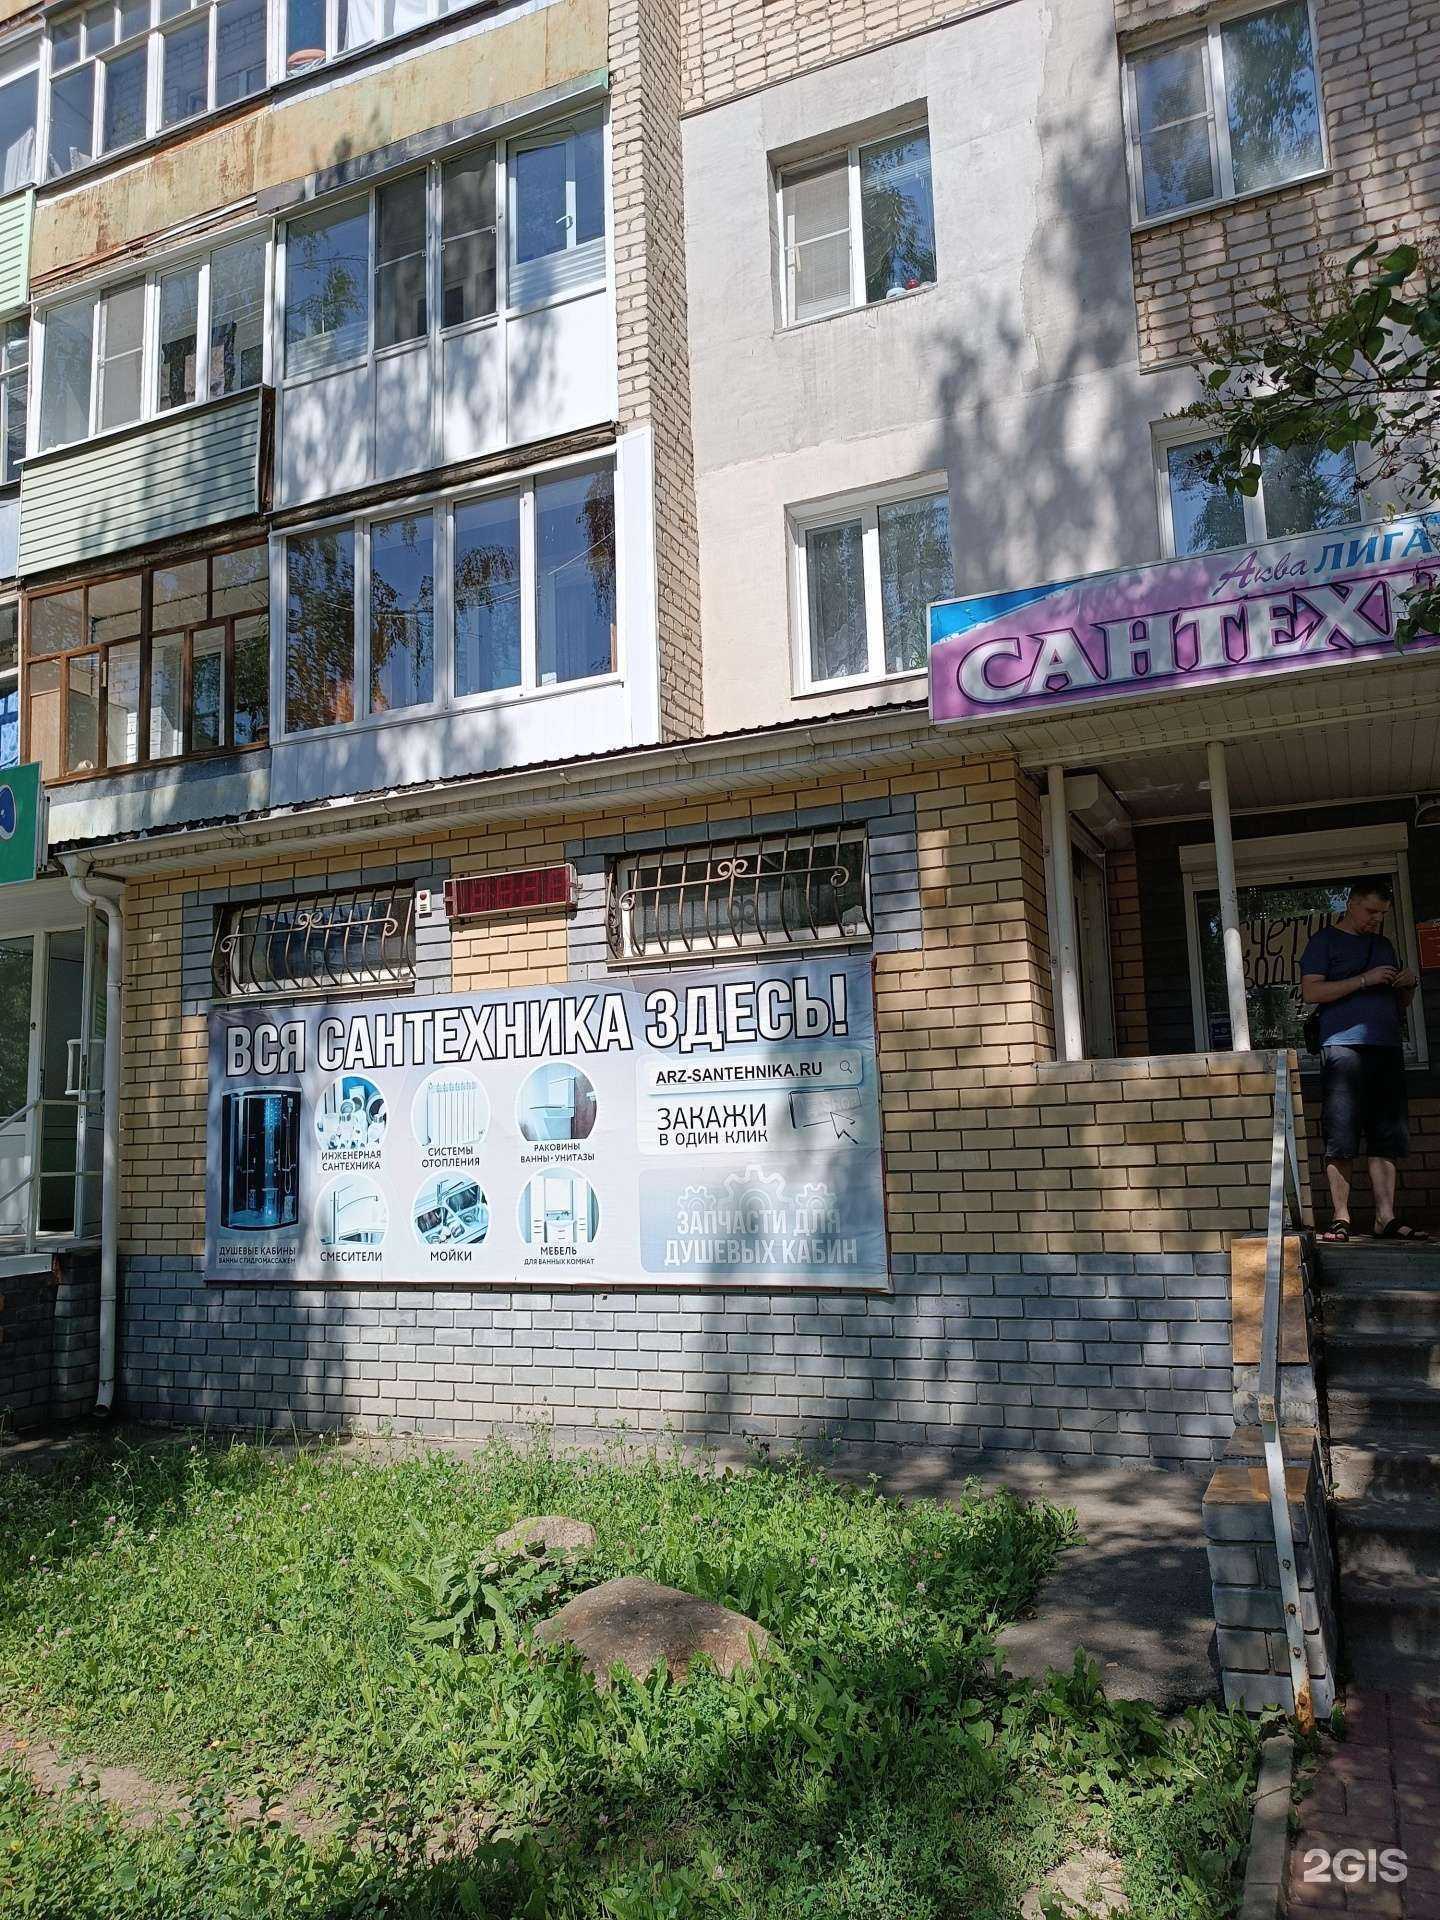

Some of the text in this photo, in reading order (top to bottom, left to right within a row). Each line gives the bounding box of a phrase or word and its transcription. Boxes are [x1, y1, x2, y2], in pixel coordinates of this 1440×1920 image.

[1213, 526, 1433, 595] Аква ЛИГА
[225, 974, 850, 1077] ВСЯ САНТЕХНИКА ЗДЕСЬ!
[655, 1061, 823, 1084] ARZ-SANTEHNIKA.RU
[656, 1103, 767, 1130] ЗАКАЖИ
[659, 1129, 768, 1148] В ОДИН КЛИК
[427, 1146, 474, 1157] СИСТЕМЫ
[533, 1143, 581, 1152] РАКОВИНЫ
[321, 1149, 382, 1161] ИНЖЕНЕРНАЯ
[321, 1160, 381, 1172] САНТЕХНИКА
[421, 1157, 480, 1168] ОТОПЛЕНИЯ
[676, 1207, 841, 1237] ЗАПЧАСТИ ДЛЯ
[219, 1246, 296, 1256] ДУШЕВЫЕ КАБИНЫ
[320, 1250, 383, 1262] СМЕСИТЕЛИ
[430, 1247, 473, 1262] МОЙКИ
[540, 1246, 577, 1256] МЕБЕЛЬ
[664, 1239, 858, 1266] ДУШЕВЫХ КАБИН
